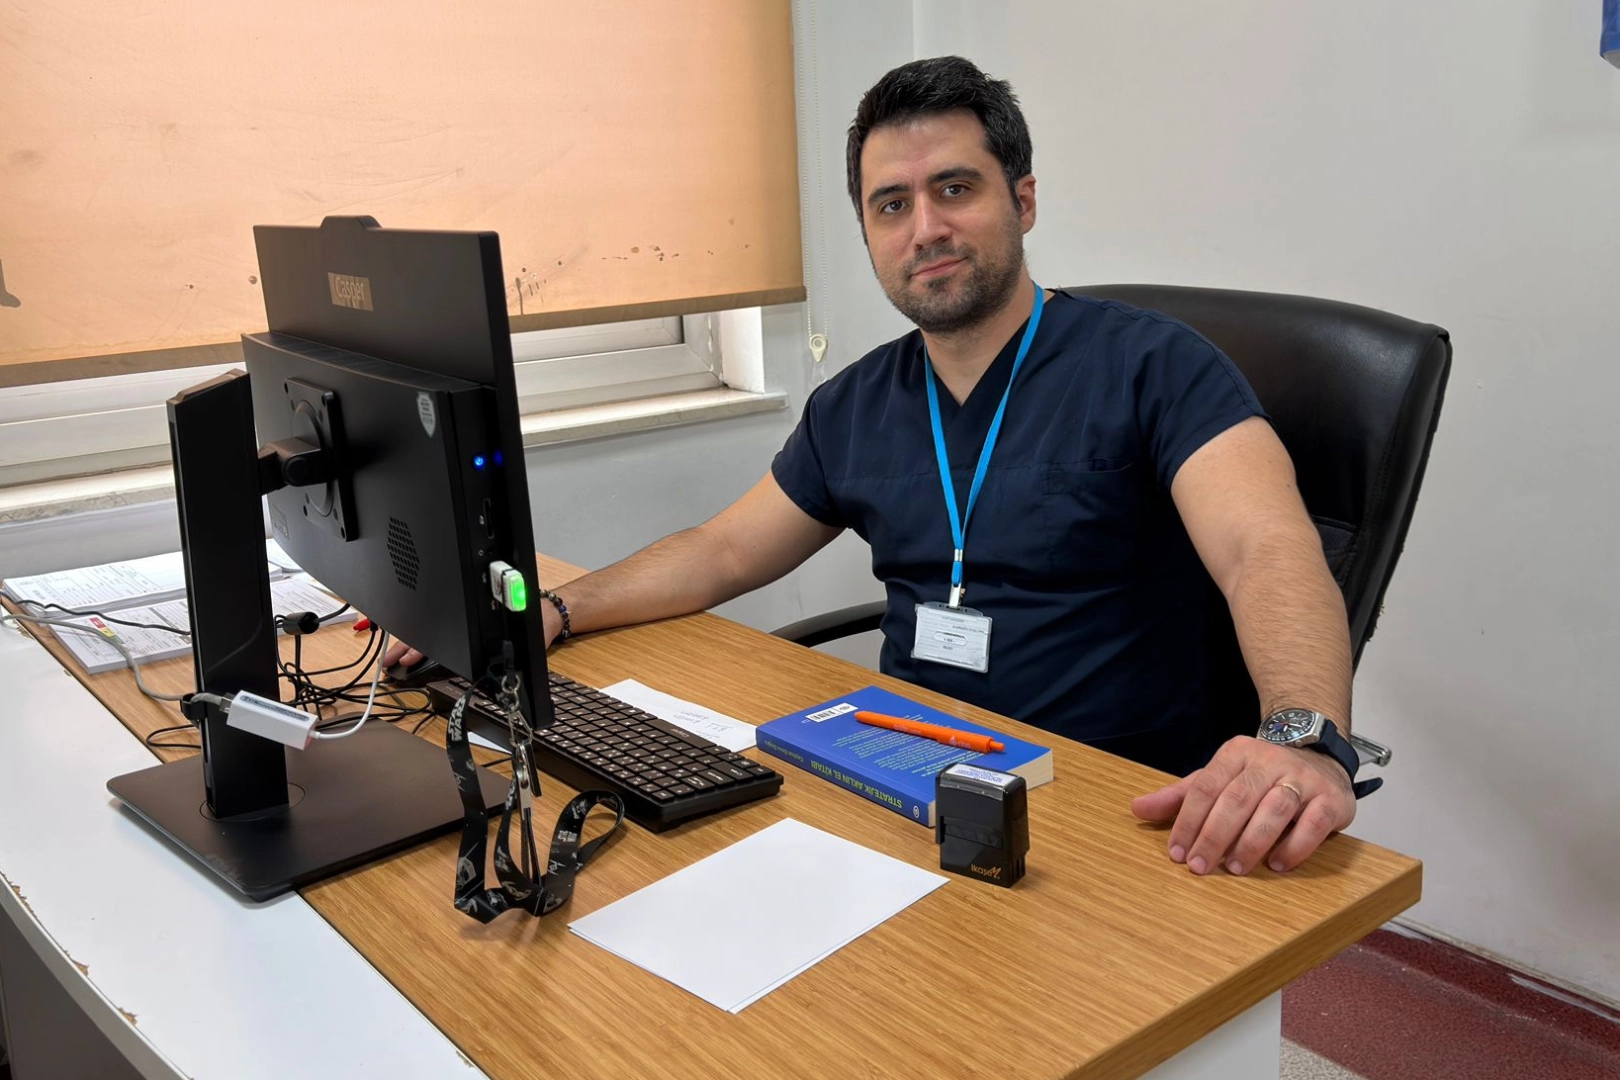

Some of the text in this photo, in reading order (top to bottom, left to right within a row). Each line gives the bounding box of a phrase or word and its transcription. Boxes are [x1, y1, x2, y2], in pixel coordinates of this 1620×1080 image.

[334, 276, 364, 308] Casper
[811, 760, 902, 808] STRATEJİK AKLIN EL KİTABI
